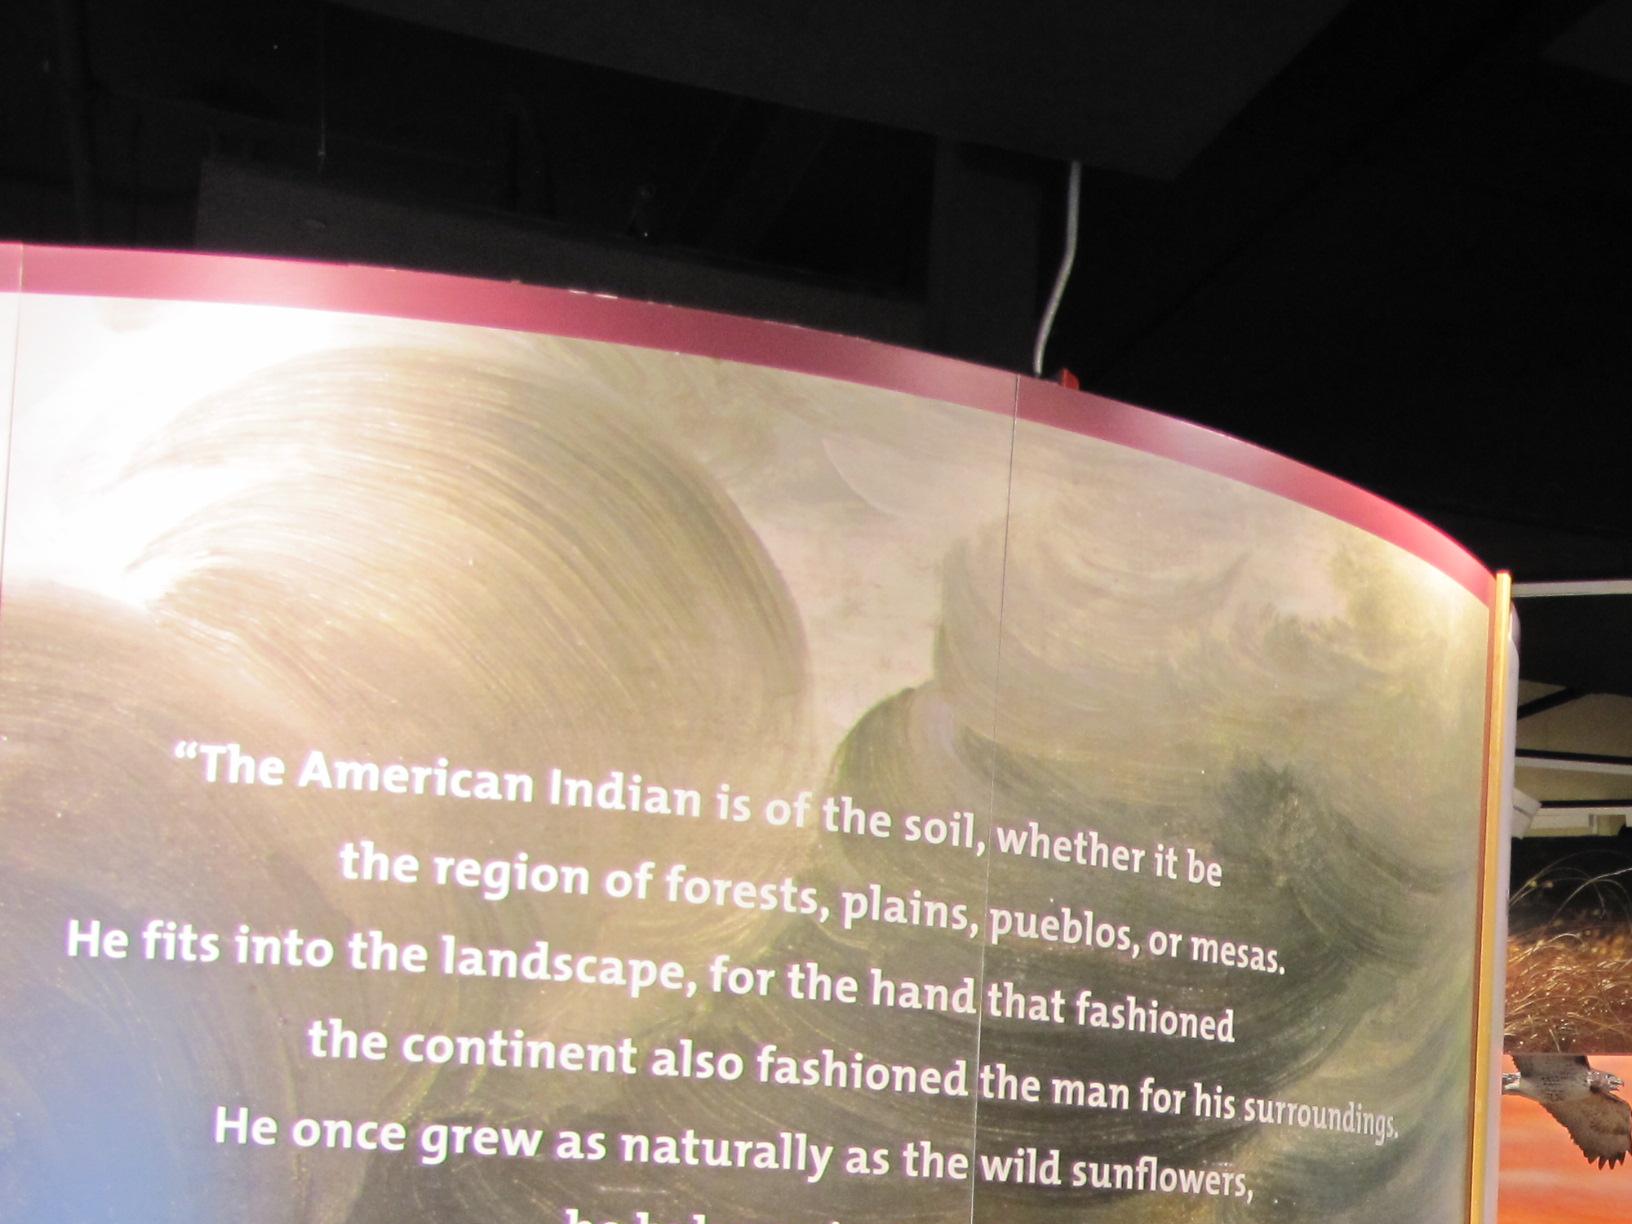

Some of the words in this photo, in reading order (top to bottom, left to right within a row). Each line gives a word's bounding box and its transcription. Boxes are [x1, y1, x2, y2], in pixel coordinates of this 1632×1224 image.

[174, 740, 285, 786] “The
[298, 751, 533, 802] American
[550, 768, 700, 817] Indian
[716, 783, 751, 821] is
[764, 791, 813, 827] of
[823, 796, 891, 837] the
[905, 812, 985, 856] soil,
[997, 822, 1145, 872] whether
[1155, 844, 1177, 879] it
[1187, 848, 1222, 887] be
[339, 840, 419, 883] the
[433, 852, 589, 901] region
[605, 861, 655, 899] of
[666, 865, 829, 923] forests,
[842, 884, 978, 938] plains,
[990, 907, 1139, 959] pueblos,
[1149, 931, 1182, 957] or
[1191, 937, 1285, 975] mesas.
[68, 920, 128, 958] He
[142, 920, 219, 962] fits
[235, 925, 333, 967] into
[348, 930, 427, 972] the
[442, 935, 696, 998] landscape,
[710, 955, 775, 995] for
[787, 962, 857, 1003] the
[871, 968, 976, 1014] hand
[988, 982, 1065, 1023] that
[1076, 991, 1235, 1042] fashioned
[308, 1018, 387, 1060] the
[402, 1029, 637, 1074] continent
[652, 1039, 743, 1080] also
[757, 1045, 968, 1096] fashioned
[980, 1063, 1040, 1102] the
[1052, 1079, 1129, 1109] man
[1140, 1077, 1186, 1114] for
[1194, 1082, 1235, 1119] his
[1244, 1098, 1398, 1146] surroundings.
[216, 1107, 277, 1145] He
[292, 1119, 405, 1151] once
[421, 1125, 543, 1165] grew
[556, 1131, 606, 1160] as
[621, 1129, 833, 1183] naturally
[846, 1147, 889, 1175] as
[903, 1141, 968, 1179] the
[981, 1148, 1061, 1185] wild
[1073, 1156, 1253, 1204] sunflowers,
